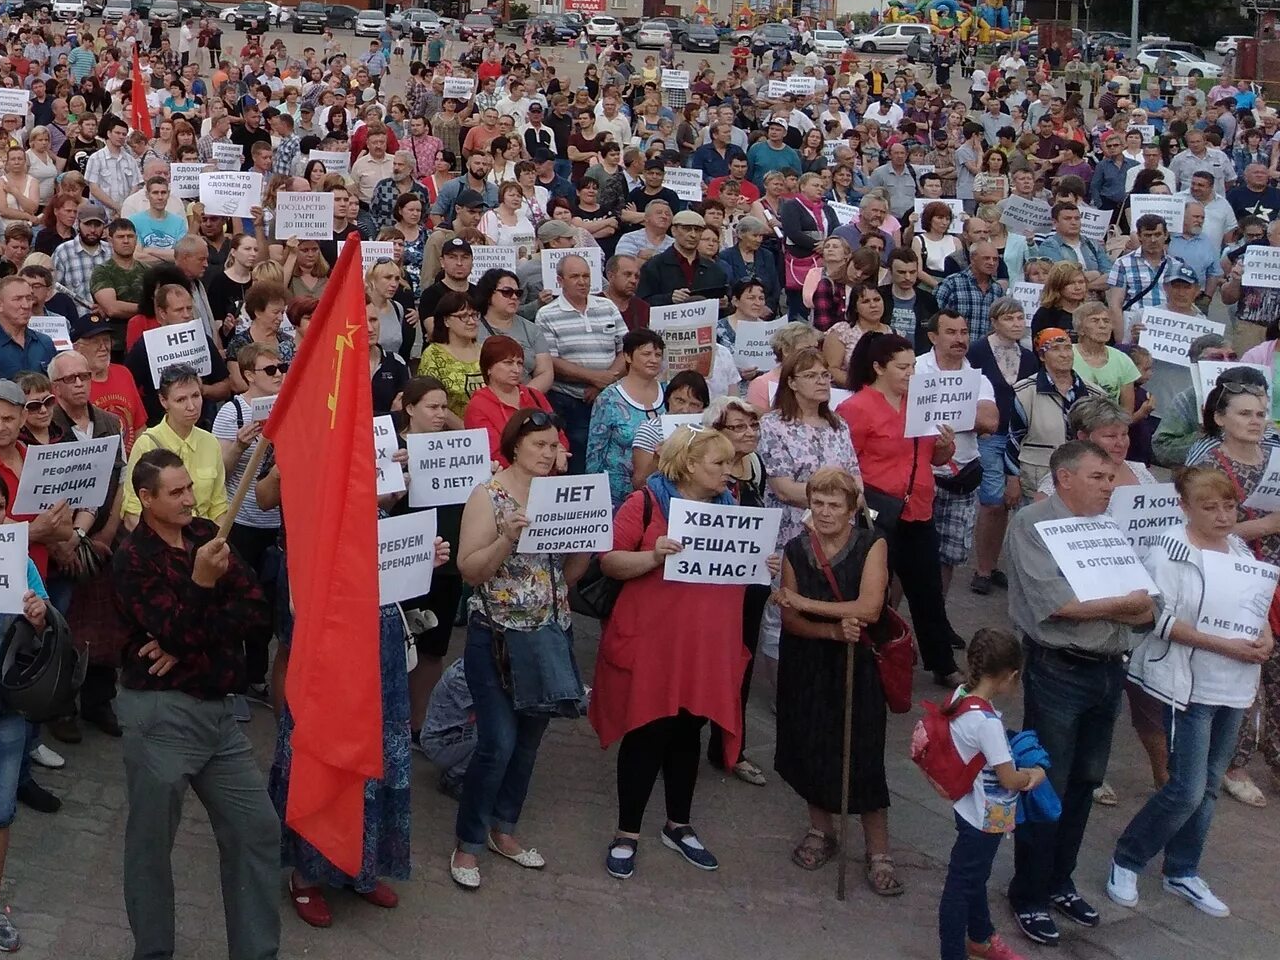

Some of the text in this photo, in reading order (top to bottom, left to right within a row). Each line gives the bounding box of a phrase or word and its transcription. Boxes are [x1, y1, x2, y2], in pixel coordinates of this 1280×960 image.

[678, 171, 700, 179] ПРОЧЬ
[1022, 202, 1048, 213] ПОЗОР
[1014, 286, 1036, 294] РУКИ
[663, 306, 707, 320] НЕ ХОЧУ
[1146, 314, 1214, 334] ДЕПУТАТЫ
[166, 330, 196, 347] НЕТ
[666, 331, 696, 340] РАВДА
[157, 345, 206, 363] ПОВЫШЕНИЮ
[924, 376, 963, 388] ЗА ЧТО
[916, 392, 972, 406] МНЕ ДАЛИ
[924, 410, 962, 422] 8 ЛЕТ?
[428, 438, 472, 450] ЗА ЧТО
[38, 444, 108, 460] ПЕНСИОННАЯ
[42, 462, 92, 476] РЕФОРМА
[420, 454, 484, 470] МНЕ ДАЛИ
[33, 476, 96, 494] ГЕНОЦИД
[432, 476, 474, 490] 8 ЛЕТ?
[555, 486, 595, 504] НЕТ
[1132, 495, 1145, 510] Я
[535, 509, 608, 524] ПОВЫШЕНИЮ
[684, 510, 764, 530] ХВАТИТ
[528, 524, 610, 538] ПЕНСИОННОГО
[1128, 516, 1182, 532] ДОЖИТЬ
[536, 540, 596, 551] ВОЗРАСТА!
[681, 536, 761, 554] РЕШАТЬ
[1067, 537, 1127, 552] МЕДВЕДЕВА
[678, 560, 702, 576] ЗА
[708, 562, 746, 577] НАС
[1078, 555, 1136, 568] В ОТСТАВКУ
[1235, 562, 1258, 575] ВОТ
[1200, 615, 1210, 625] А
[1214, 619, 1231, 630] НЕ
